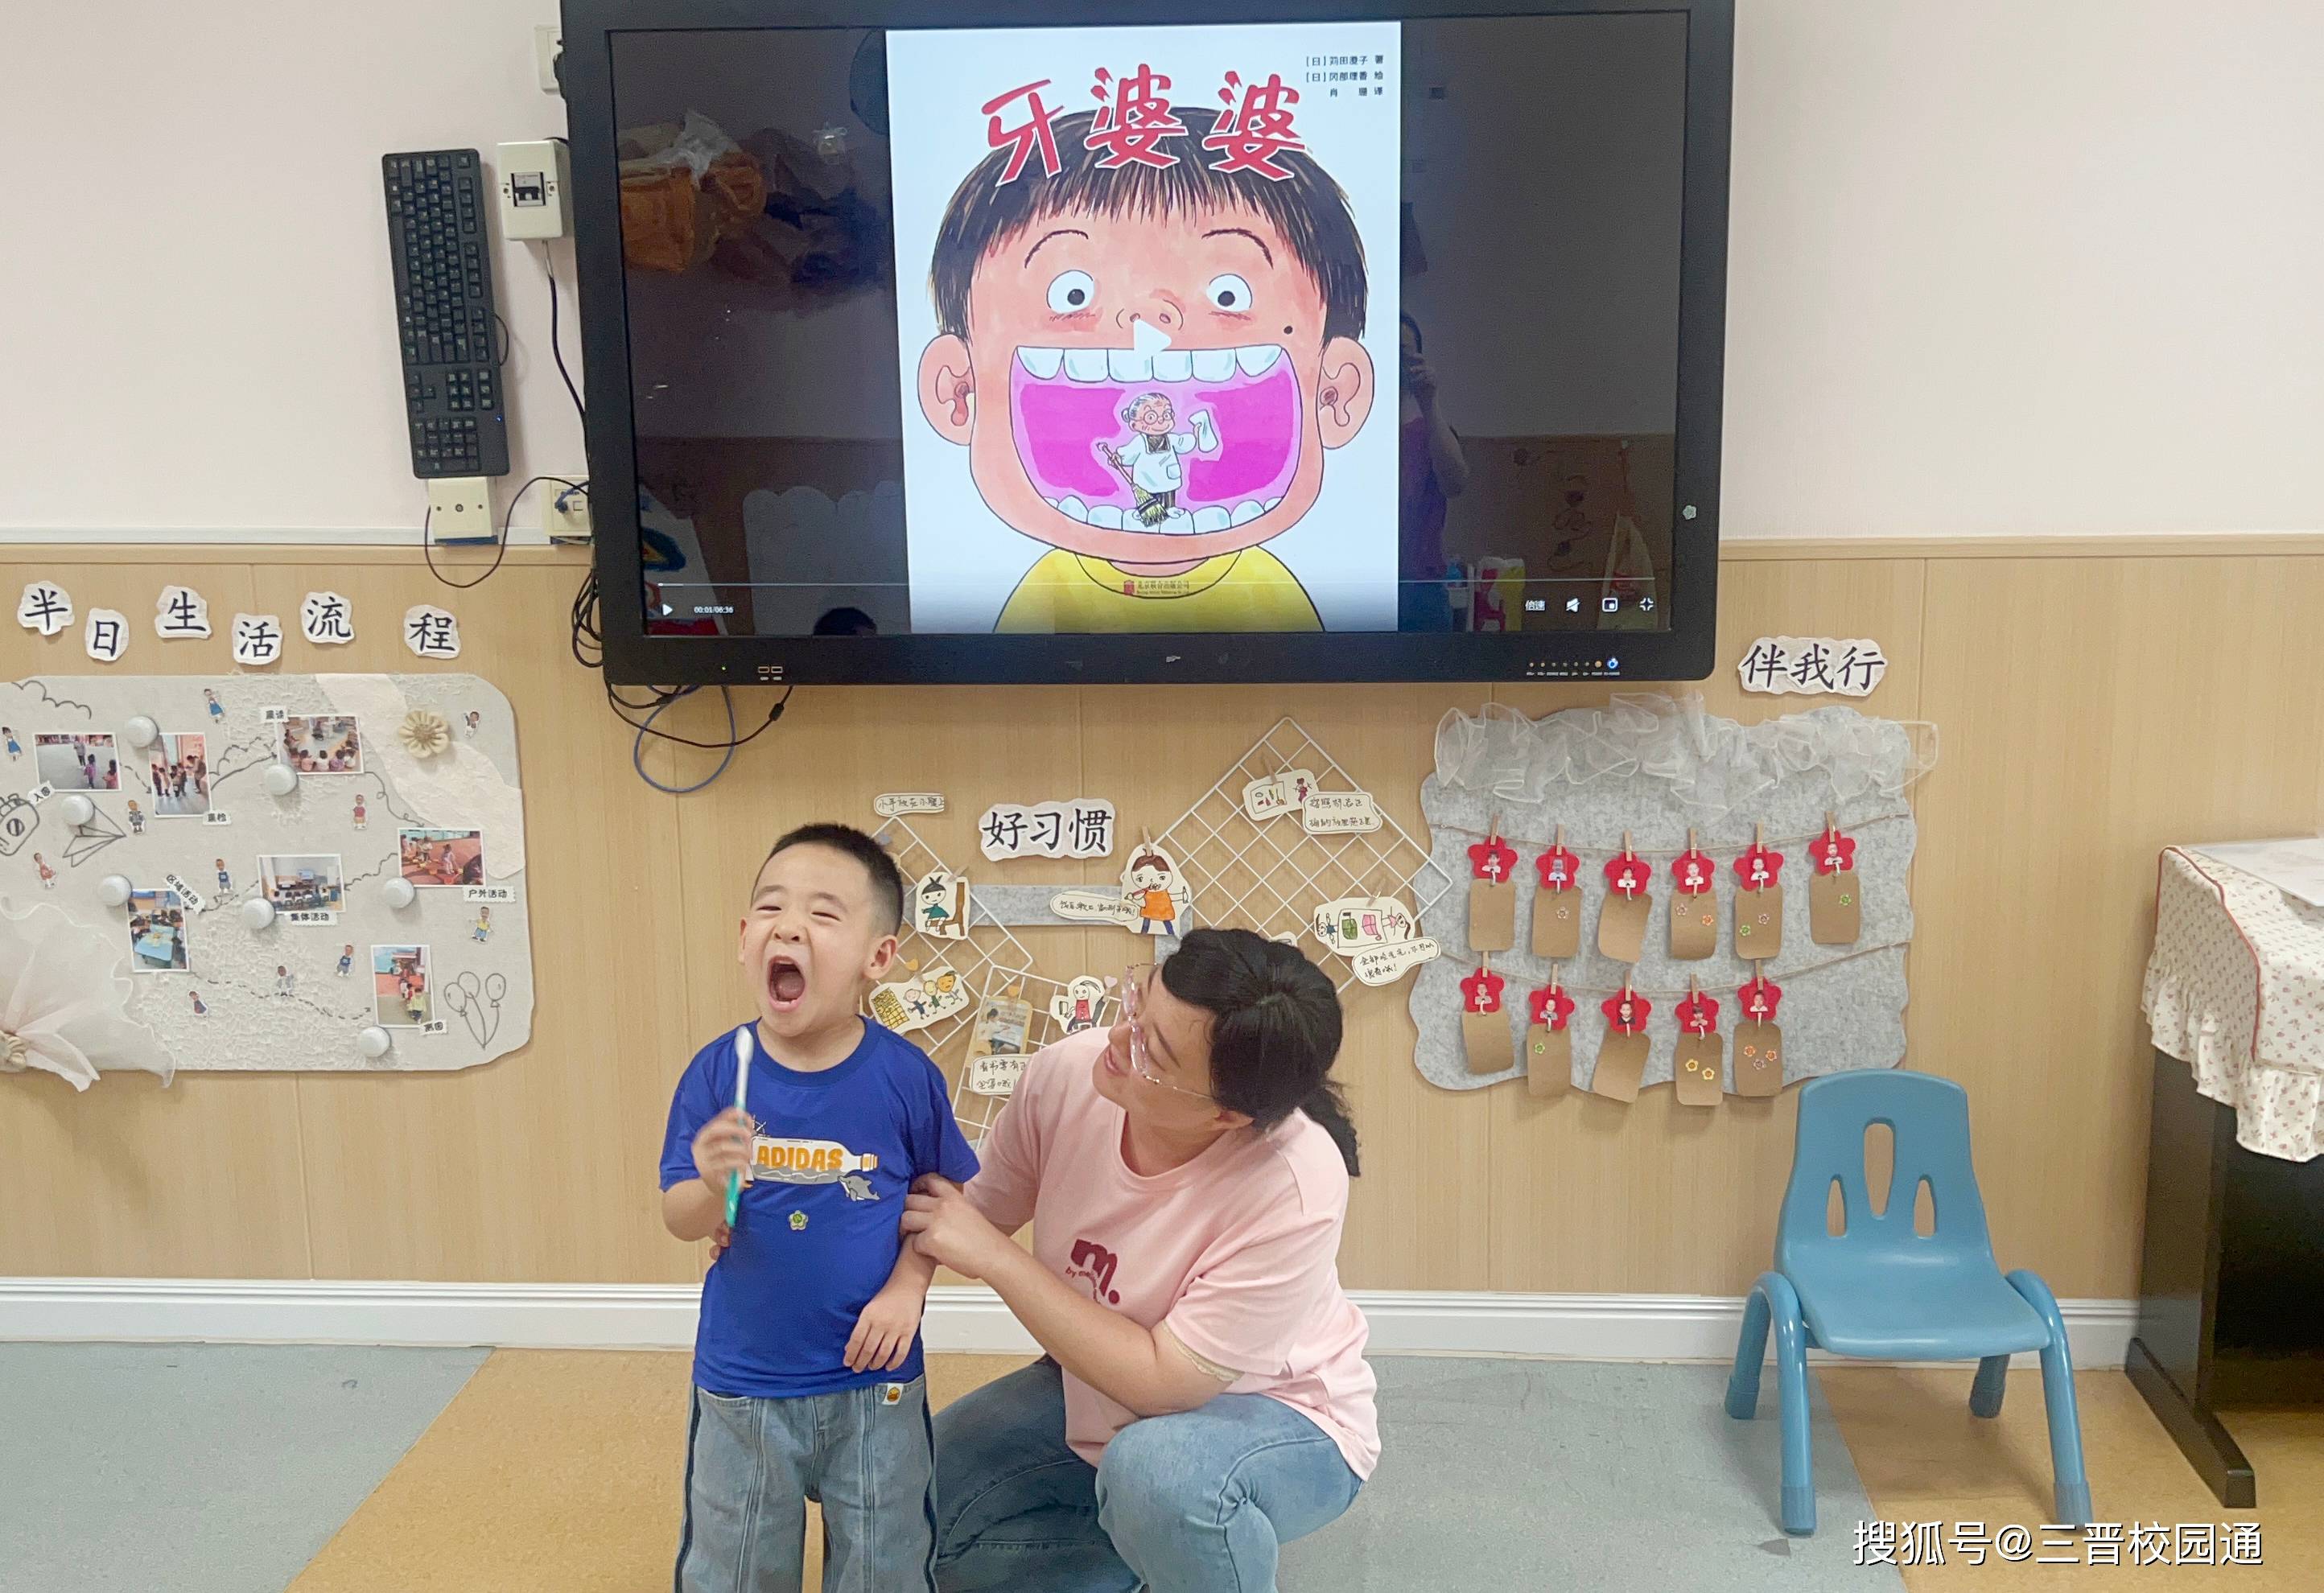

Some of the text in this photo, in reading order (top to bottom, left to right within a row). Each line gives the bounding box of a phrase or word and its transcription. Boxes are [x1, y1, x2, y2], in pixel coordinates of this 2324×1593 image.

[982, 64, 1306, 187] 牙婆婆
[1741, 643, 1885, 690] 伴我行
[982, 808, 1112, 852] 好习惯
[468, 889, 508, 899] 户外活动
[290, 912, 329, 922] 集体活动
[756, 1145, 844, 1172] ADIDAS
